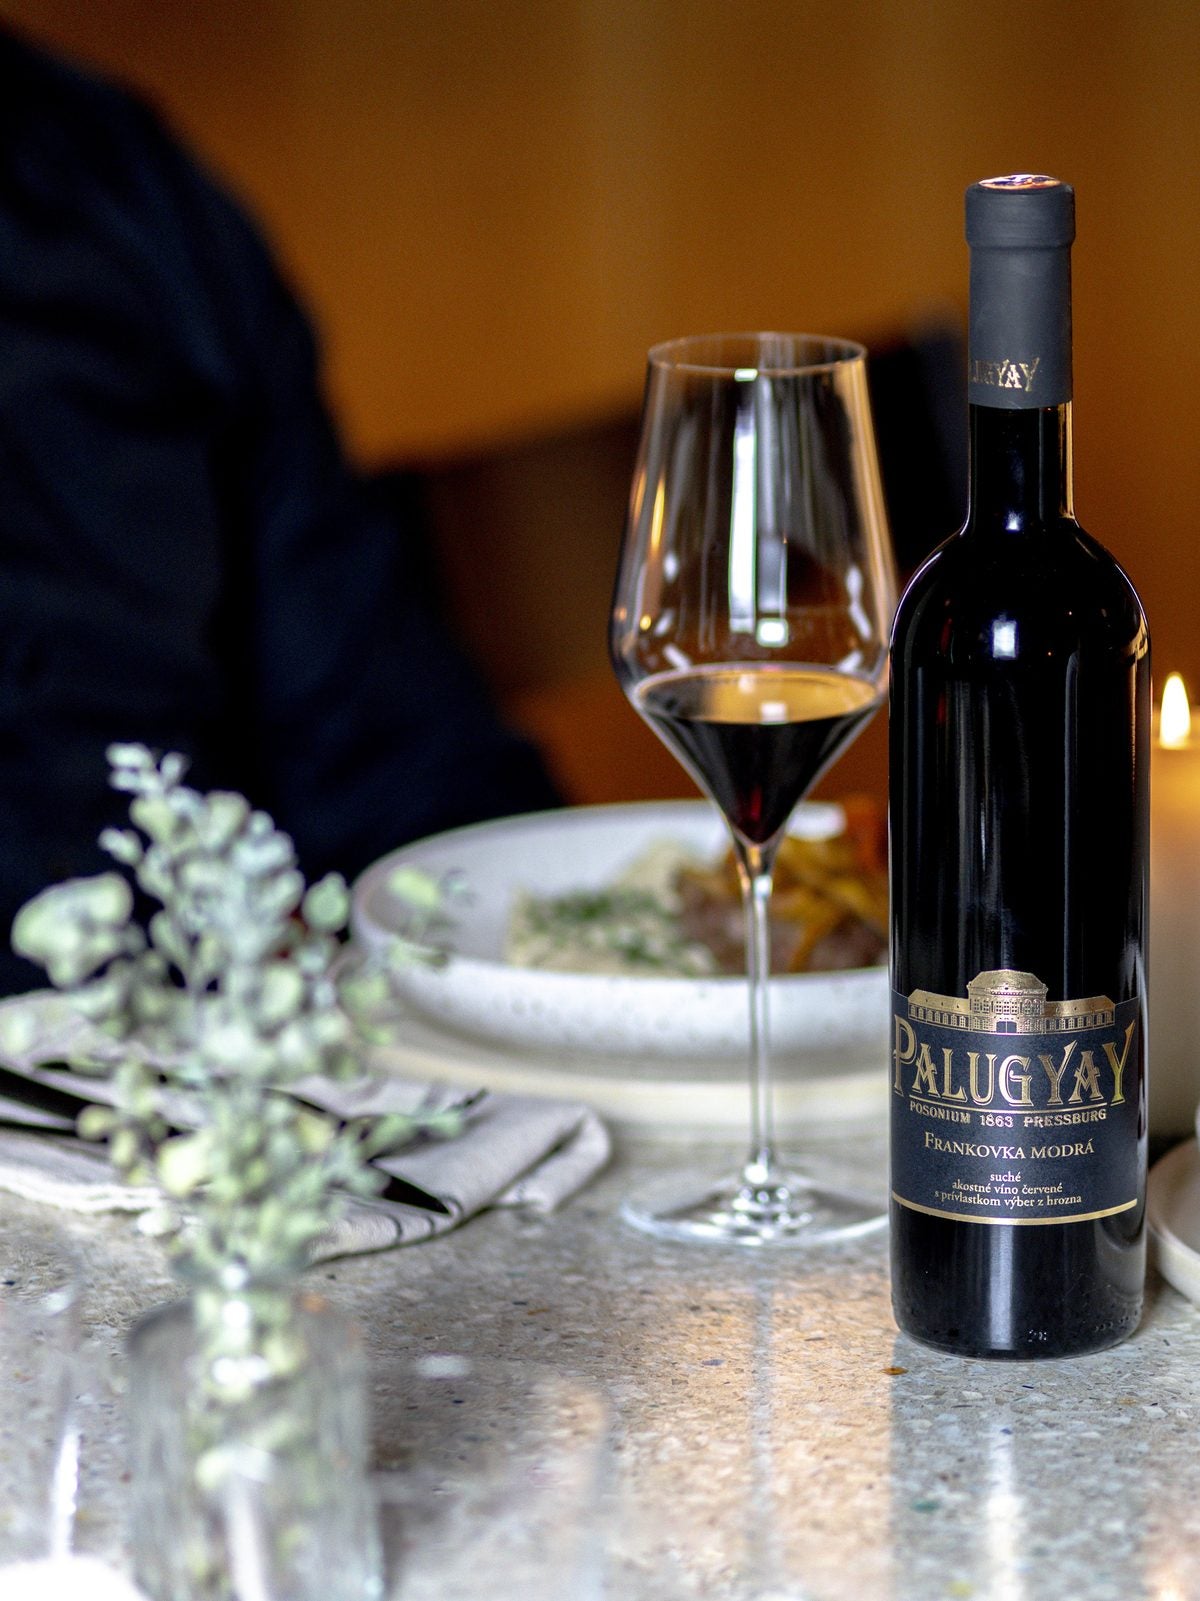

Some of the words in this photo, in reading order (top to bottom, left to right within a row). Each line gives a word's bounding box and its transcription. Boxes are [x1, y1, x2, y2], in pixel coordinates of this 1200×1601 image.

[893, 1014, 1136, 1107] PALUGYAY
[909, 1100, 971, 1124] POSONIUM
[980, 1113, 1014, 1128] 1863
[1023, 1108, 1107, 1128] PRESSBURG
[924, 1131, 1026, 1159] FRANKOVKA
[1030, 1138, 1095, 1159] MODRÁ
[952, 1179, 991, 1193] akostné
[994, 1183, 1018, 1195] víno
[1021, 1182, 1063, 1195] červené
[990, 1170, 1021, 1182] suché
[941, 1191, 1001, 1206] prívlastkom
[1003, 1195, 1034, 1210] výber
[1046, 1194, 1082, 1206] hrozna
